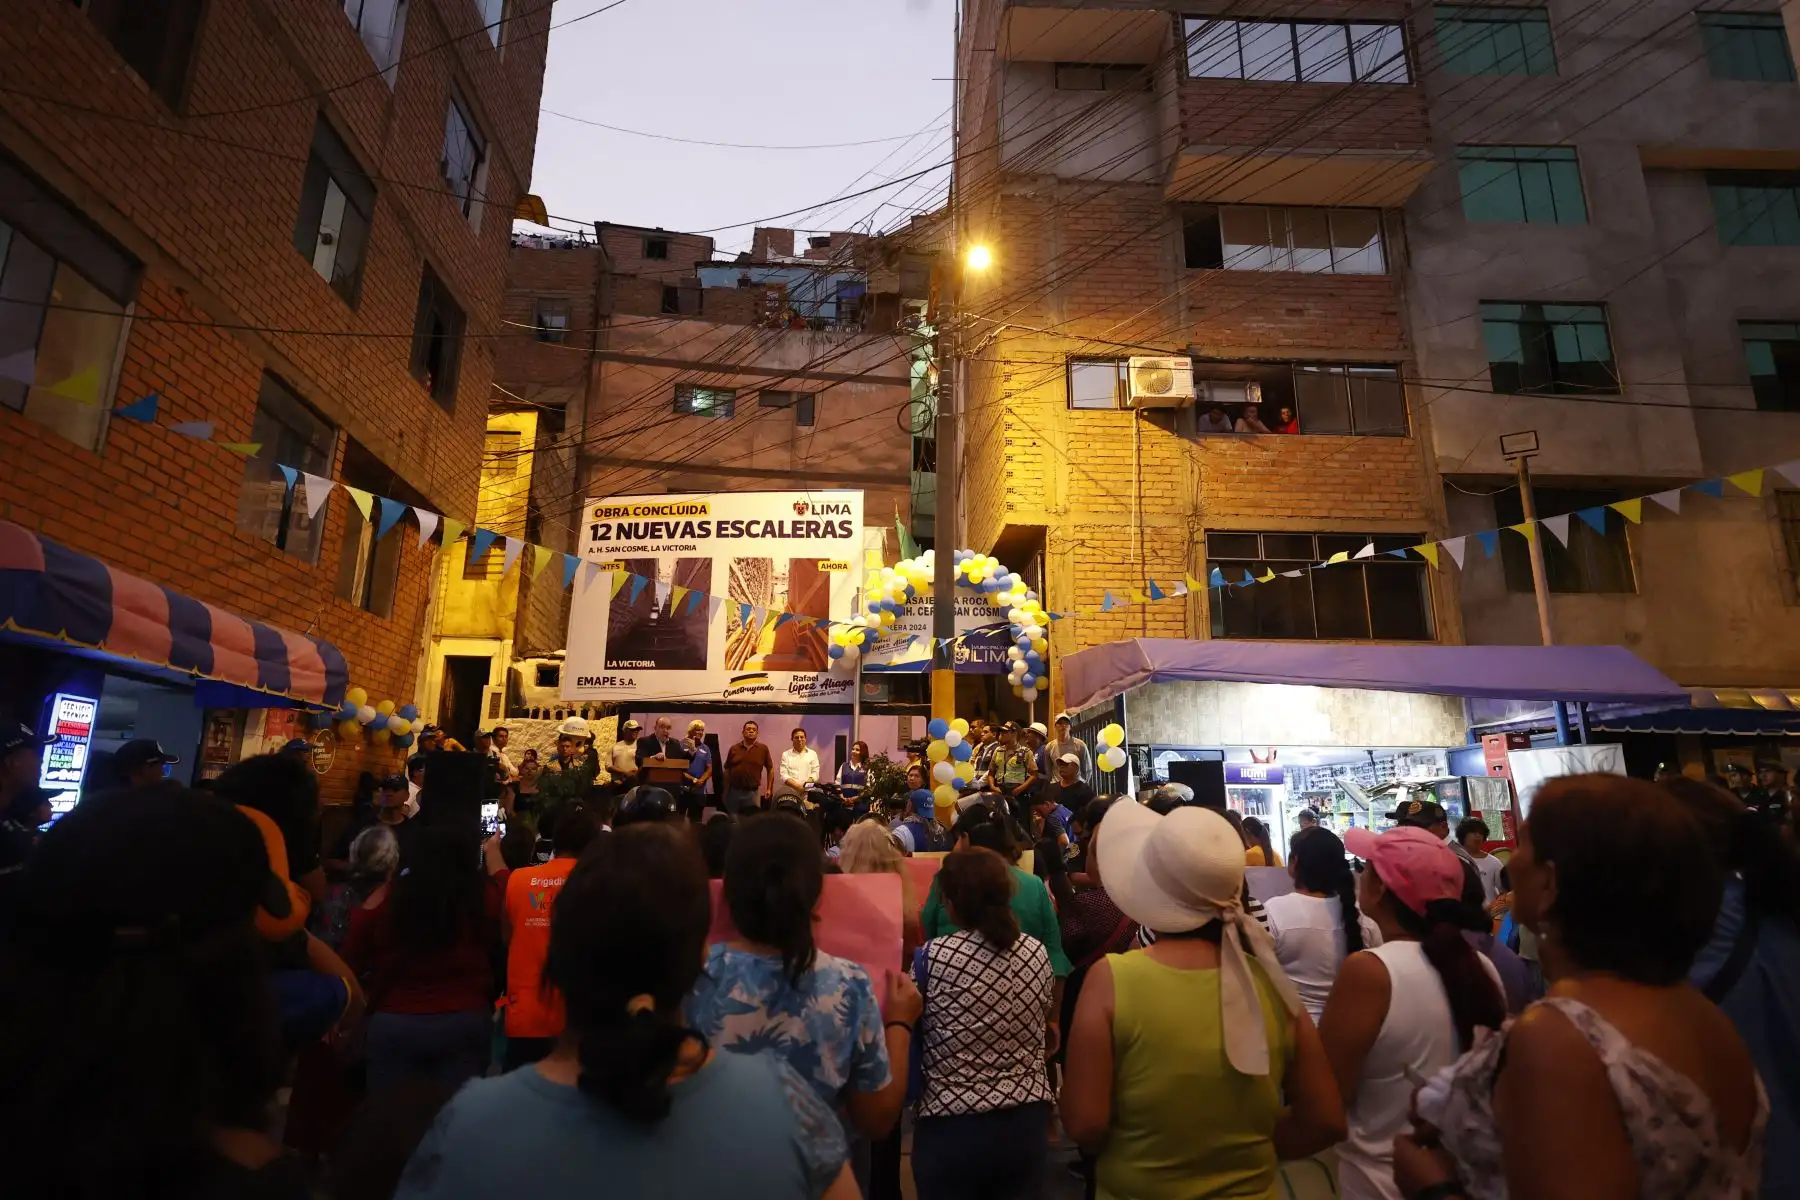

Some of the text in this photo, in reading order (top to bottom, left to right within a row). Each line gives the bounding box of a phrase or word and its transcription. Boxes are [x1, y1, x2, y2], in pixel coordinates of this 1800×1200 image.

[594, 504, 708, 518] OBRA CONCLUIDA
[811, 504, 852, 516] LIMA
[590, 519, 853, 541] 12 NUEVAS ESCALERAS
[621, 545, 650, 553] COSME,
[661, 544, 697, 552] VICTORIA
[904, 596, 935, 605] ASAJE
[962, 597, 989, 605] ROCA
[972, 606, 1000, 617] COSM
[973, 649, 1006, 663] LIM
[606, 660, 656, 668] LA VICTORIA
[576, 676, 637, 686] EMAPE S.A.
[792, 674, 819, 682] Rafael
[722, 684, 774, 698] Construyendo
